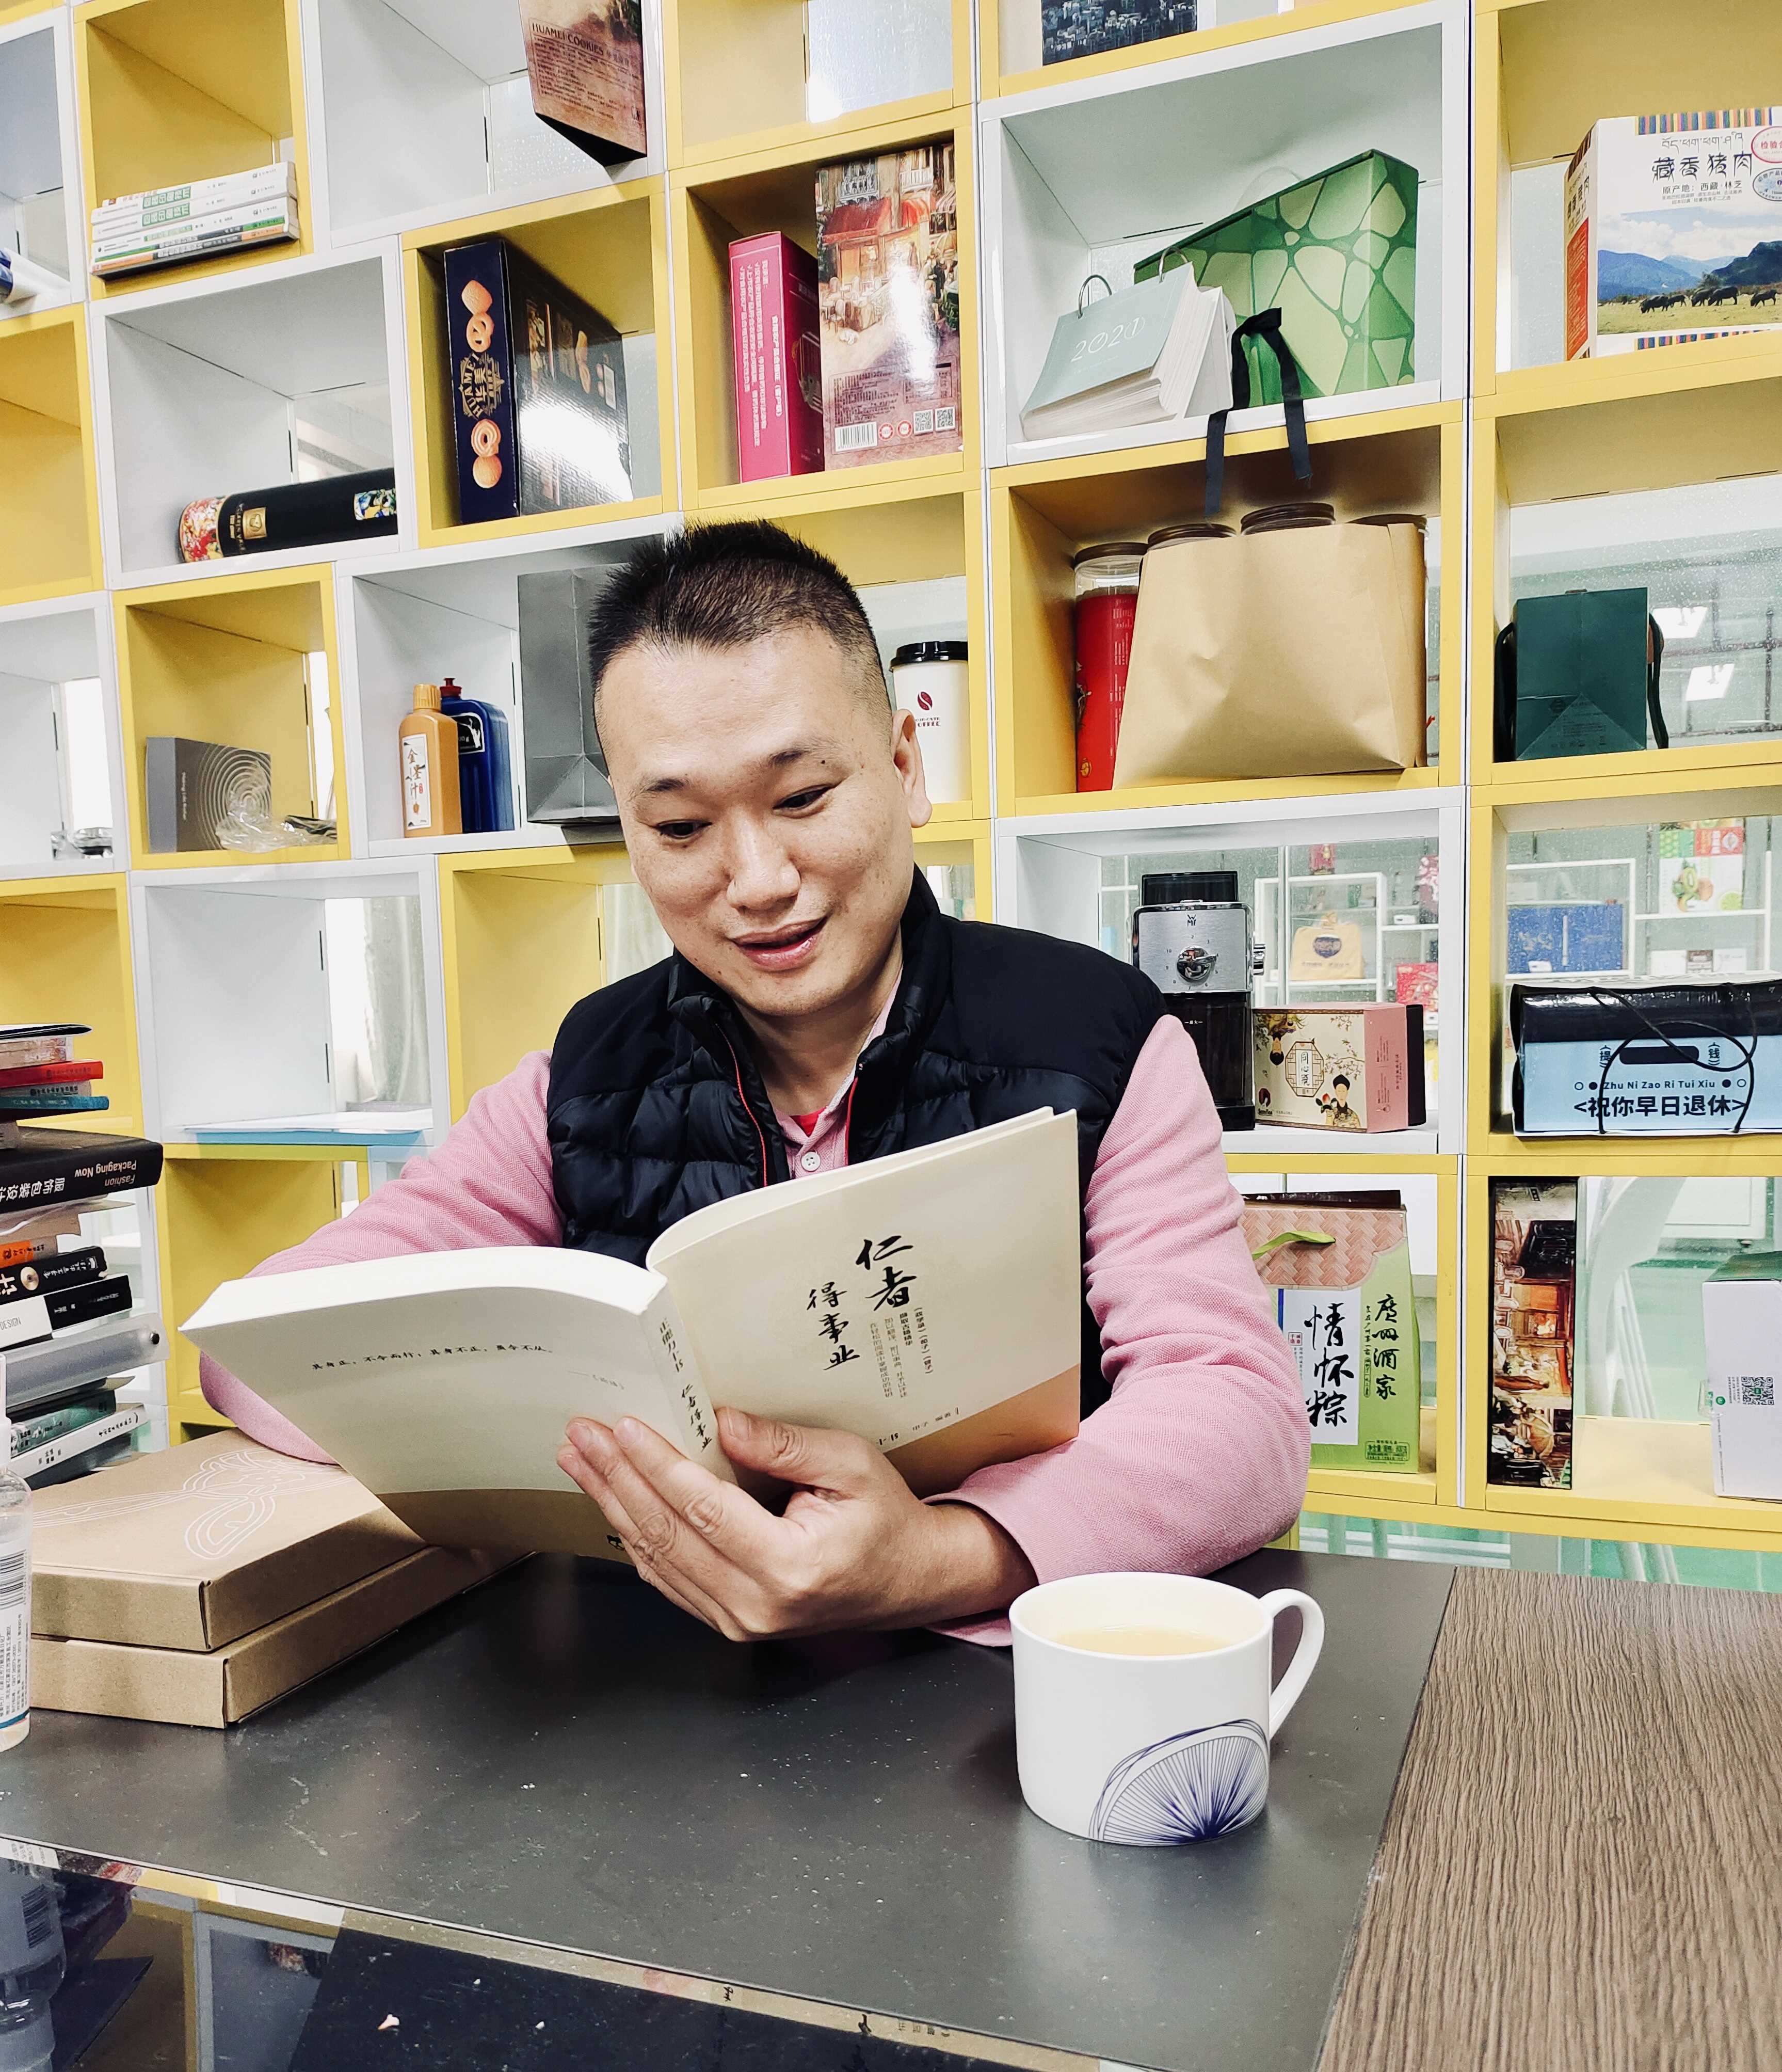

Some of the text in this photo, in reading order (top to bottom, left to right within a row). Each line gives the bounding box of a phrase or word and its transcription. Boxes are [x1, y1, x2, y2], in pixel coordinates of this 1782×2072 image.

[568, 35, 604, 55] COOKIES
[1651, 150, 1752, 182] 藏香猪肉
[1070, 316, 1146, 362] 2021
[463, 353, 484, 418] HUAMEI
[1627, 1081, 1638, 1089] Ni
[1665, 1080, 1675, 1088] Ri
[1678, 1080, 1694, 1088] Tui
[1698, 1079, 1715, 1088] Xiu
[74, 1159, 137, 1178] Packaging Now
[105, 1173, 135, 1187] Fashion
